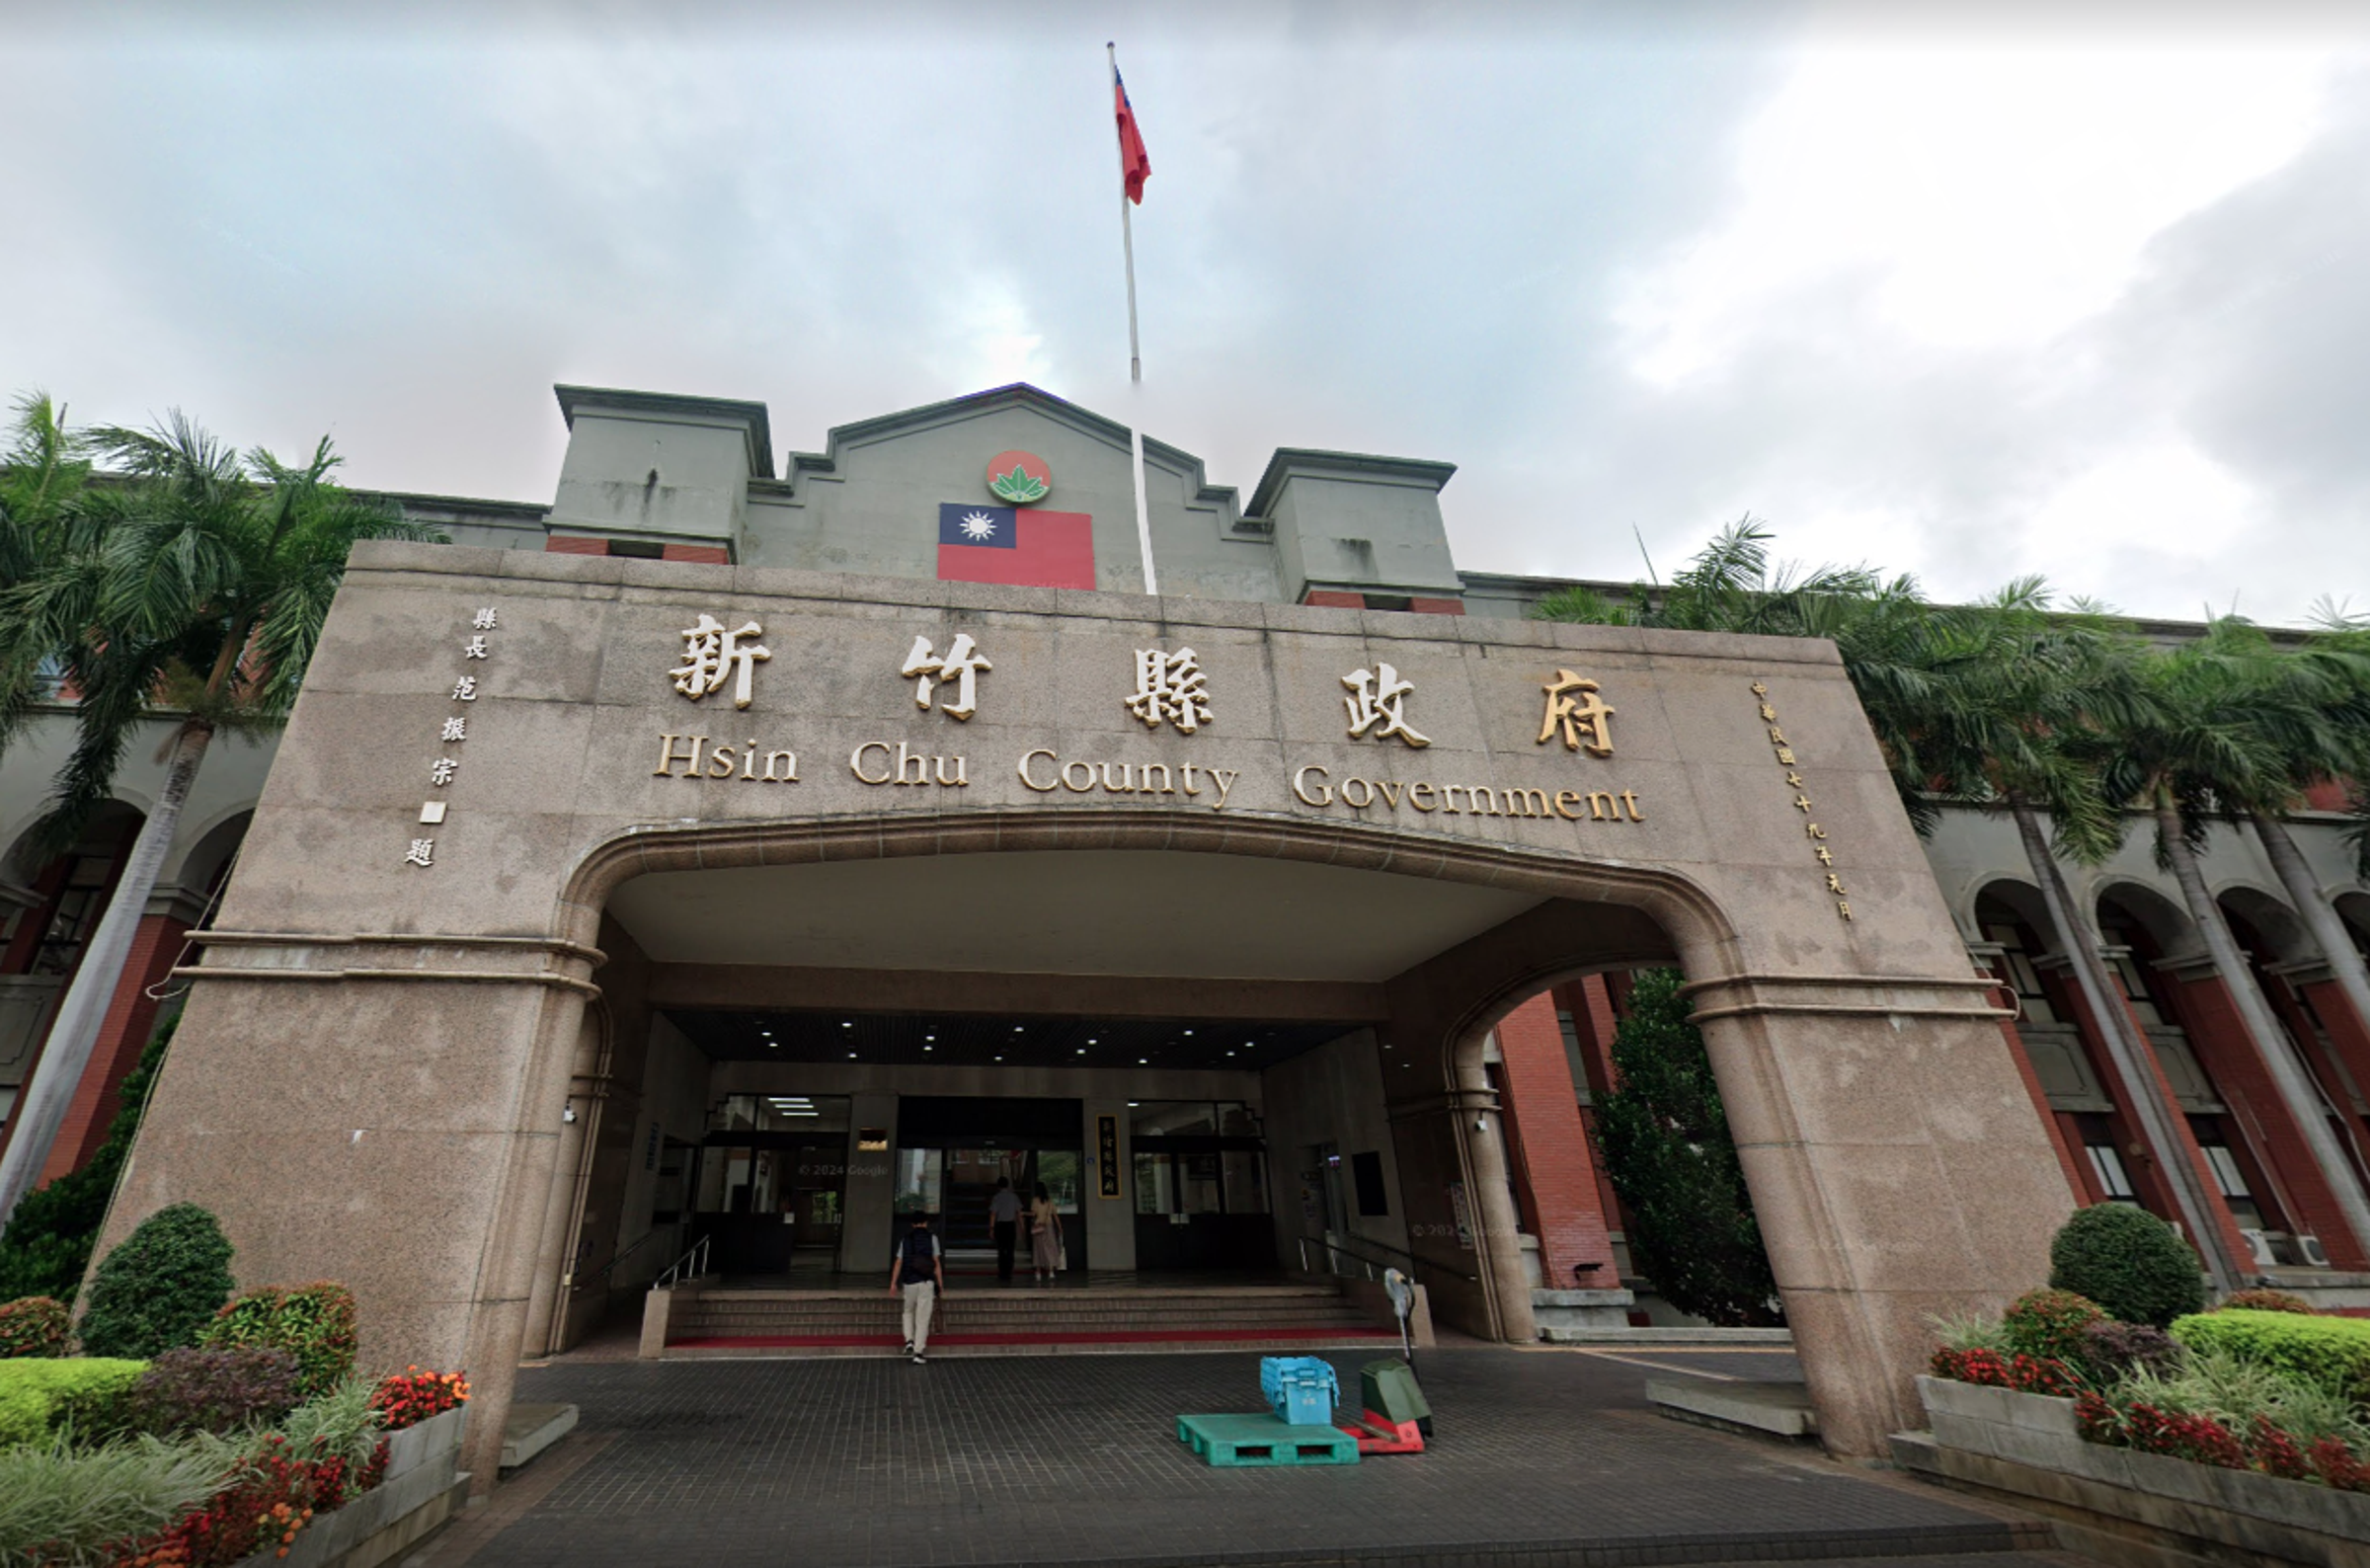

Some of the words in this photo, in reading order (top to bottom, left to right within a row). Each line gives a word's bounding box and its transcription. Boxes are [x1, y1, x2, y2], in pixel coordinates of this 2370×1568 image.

[669, 613, 1616, 757] 新竹縣政府
[653, 734, 799, 783] Hsin
[850, 742, 969, 787] Chu
[1017, 748, 1238, 811] County
[1294, 765, 1647, 823] Government
